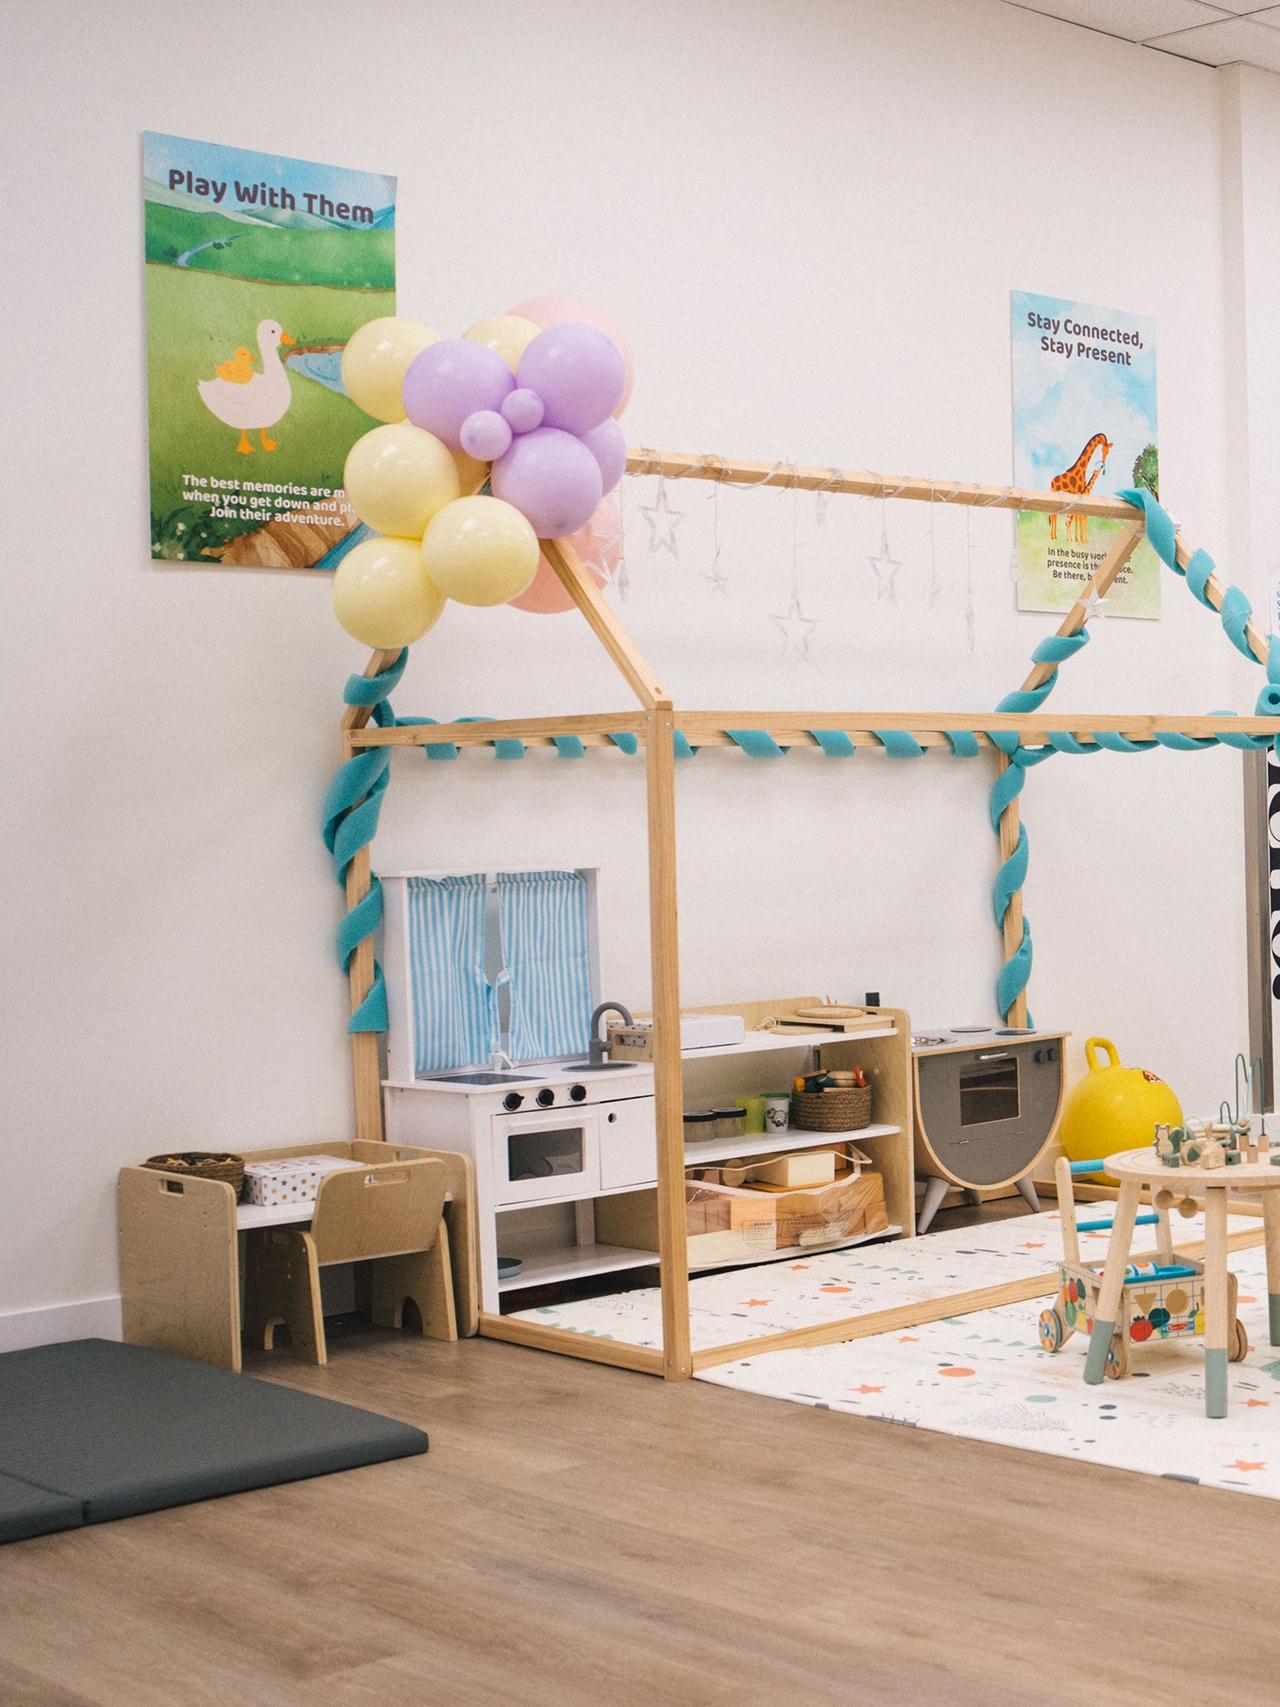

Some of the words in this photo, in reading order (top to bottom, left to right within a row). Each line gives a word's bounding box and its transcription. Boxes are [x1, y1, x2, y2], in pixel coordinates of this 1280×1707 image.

[169, 169, 227, 203] Play
[234, 180, 296, 211] With
[302, 192, 374, 224] Them
[1027, 311, 1060, 335] Stay
[1063, 319, 1143, 349] Connected,
[1041, 335, 1073, 359] Stay
[1077, 342, 1131, 366] Present
[182, 474, 207, 488] The
[210, 476, 240, 490] best
[242, 482, 308, 496] memories
[310, 486, 333, 498] are
[182, 490, 220, 503] when
[222, 493, 247, 506] you
[249, 496, 272, 509] get
[274, 497, 310, 510] down
[313, 501, 337, 513] and
[209, 505, 237, 519] Join
[239, 507, 272, 522] their
[274, 511, 345, 527] adventure.
[1047, 560, 1081, 570] presence
[1082, 561, 1090, 570] is
[1048, 547, 1055, 556] In
[1057, 548, 1070, 558] the
[1071, 549, 1089, 560] busy
[1090, 552, 1107, 560] wor
[1052, 570, 1062, 579] Be
[1063, 571, 1086, 581] there,
